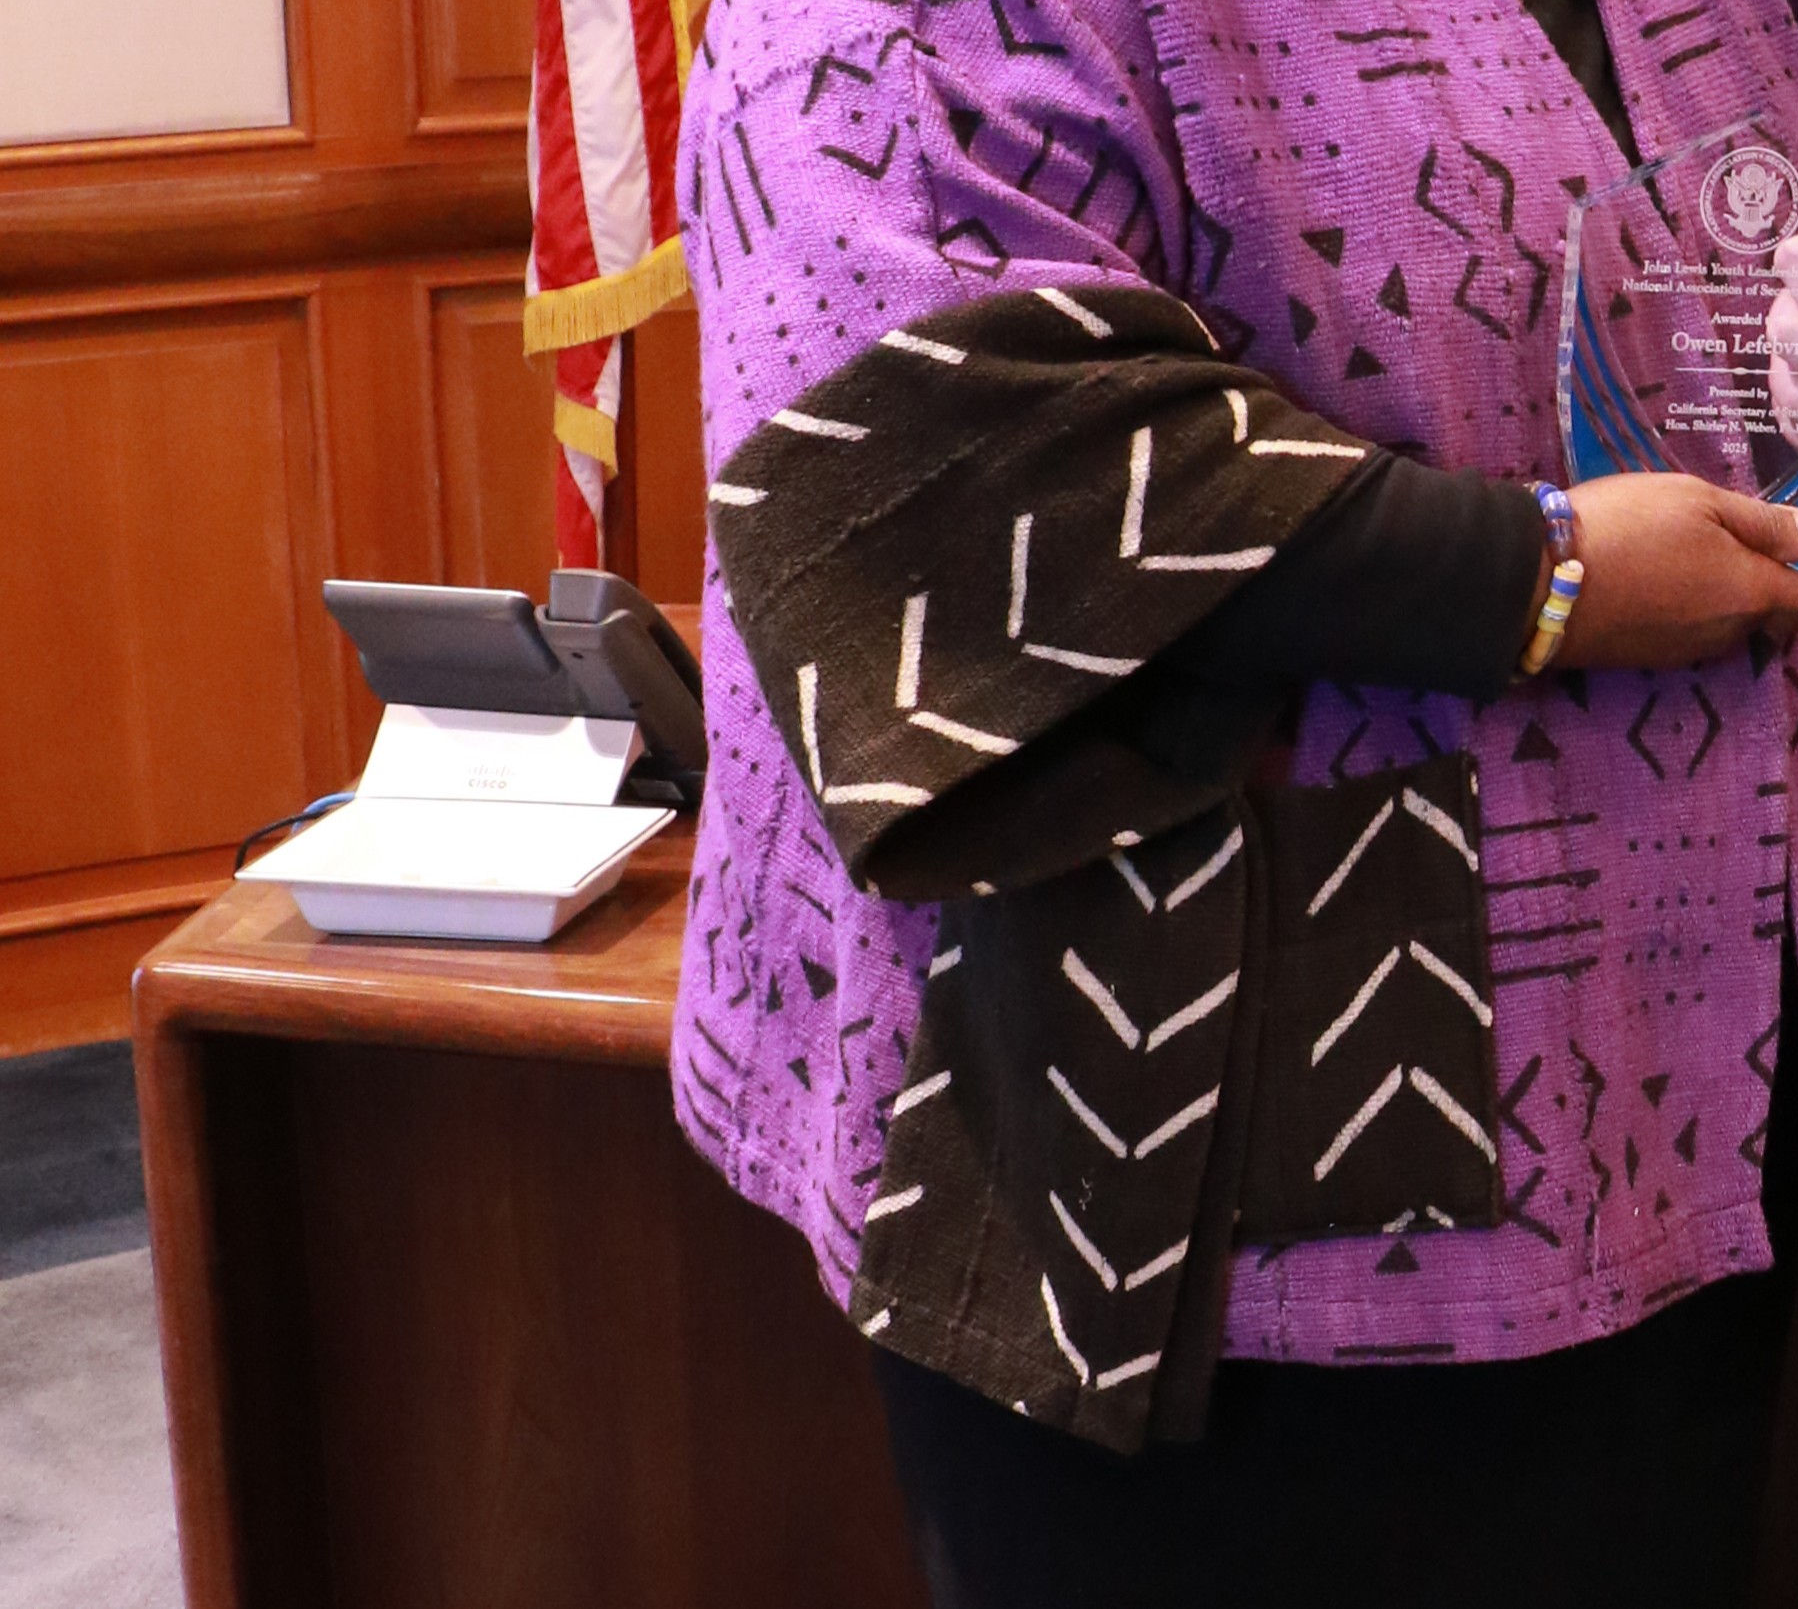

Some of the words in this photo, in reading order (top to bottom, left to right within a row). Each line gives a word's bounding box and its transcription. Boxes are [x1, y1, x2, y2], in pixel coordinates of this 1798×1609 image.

[1642, 259, 1672, 275] John
[1674, 261, 1708, 275] Lewis
[1711, 262, 1745, 277] Youth
[1622, 277, 1673, 293] National
[1676, 280, 1743, 296] Association
[1745, 283, 1759, 296] of
[1711, 311, 1763, 326] Awarded
[1671, 331, 1728, 353] Owen
[1709, 386, 1755, 399] Presented
[1756, 387, 1769, 400] by
[1668, 402, 1718, 416] California
[1720, 404, 1767, 419] Secretary
[1665, 419, 1691, 431] Hon.
[1692, 420, 1728, 433] Shirley
[1729, 421, 1742, 433] N.
[1743, 421, 1778, 435] Weber,
[1721, 442, 1748, 455] 2025
